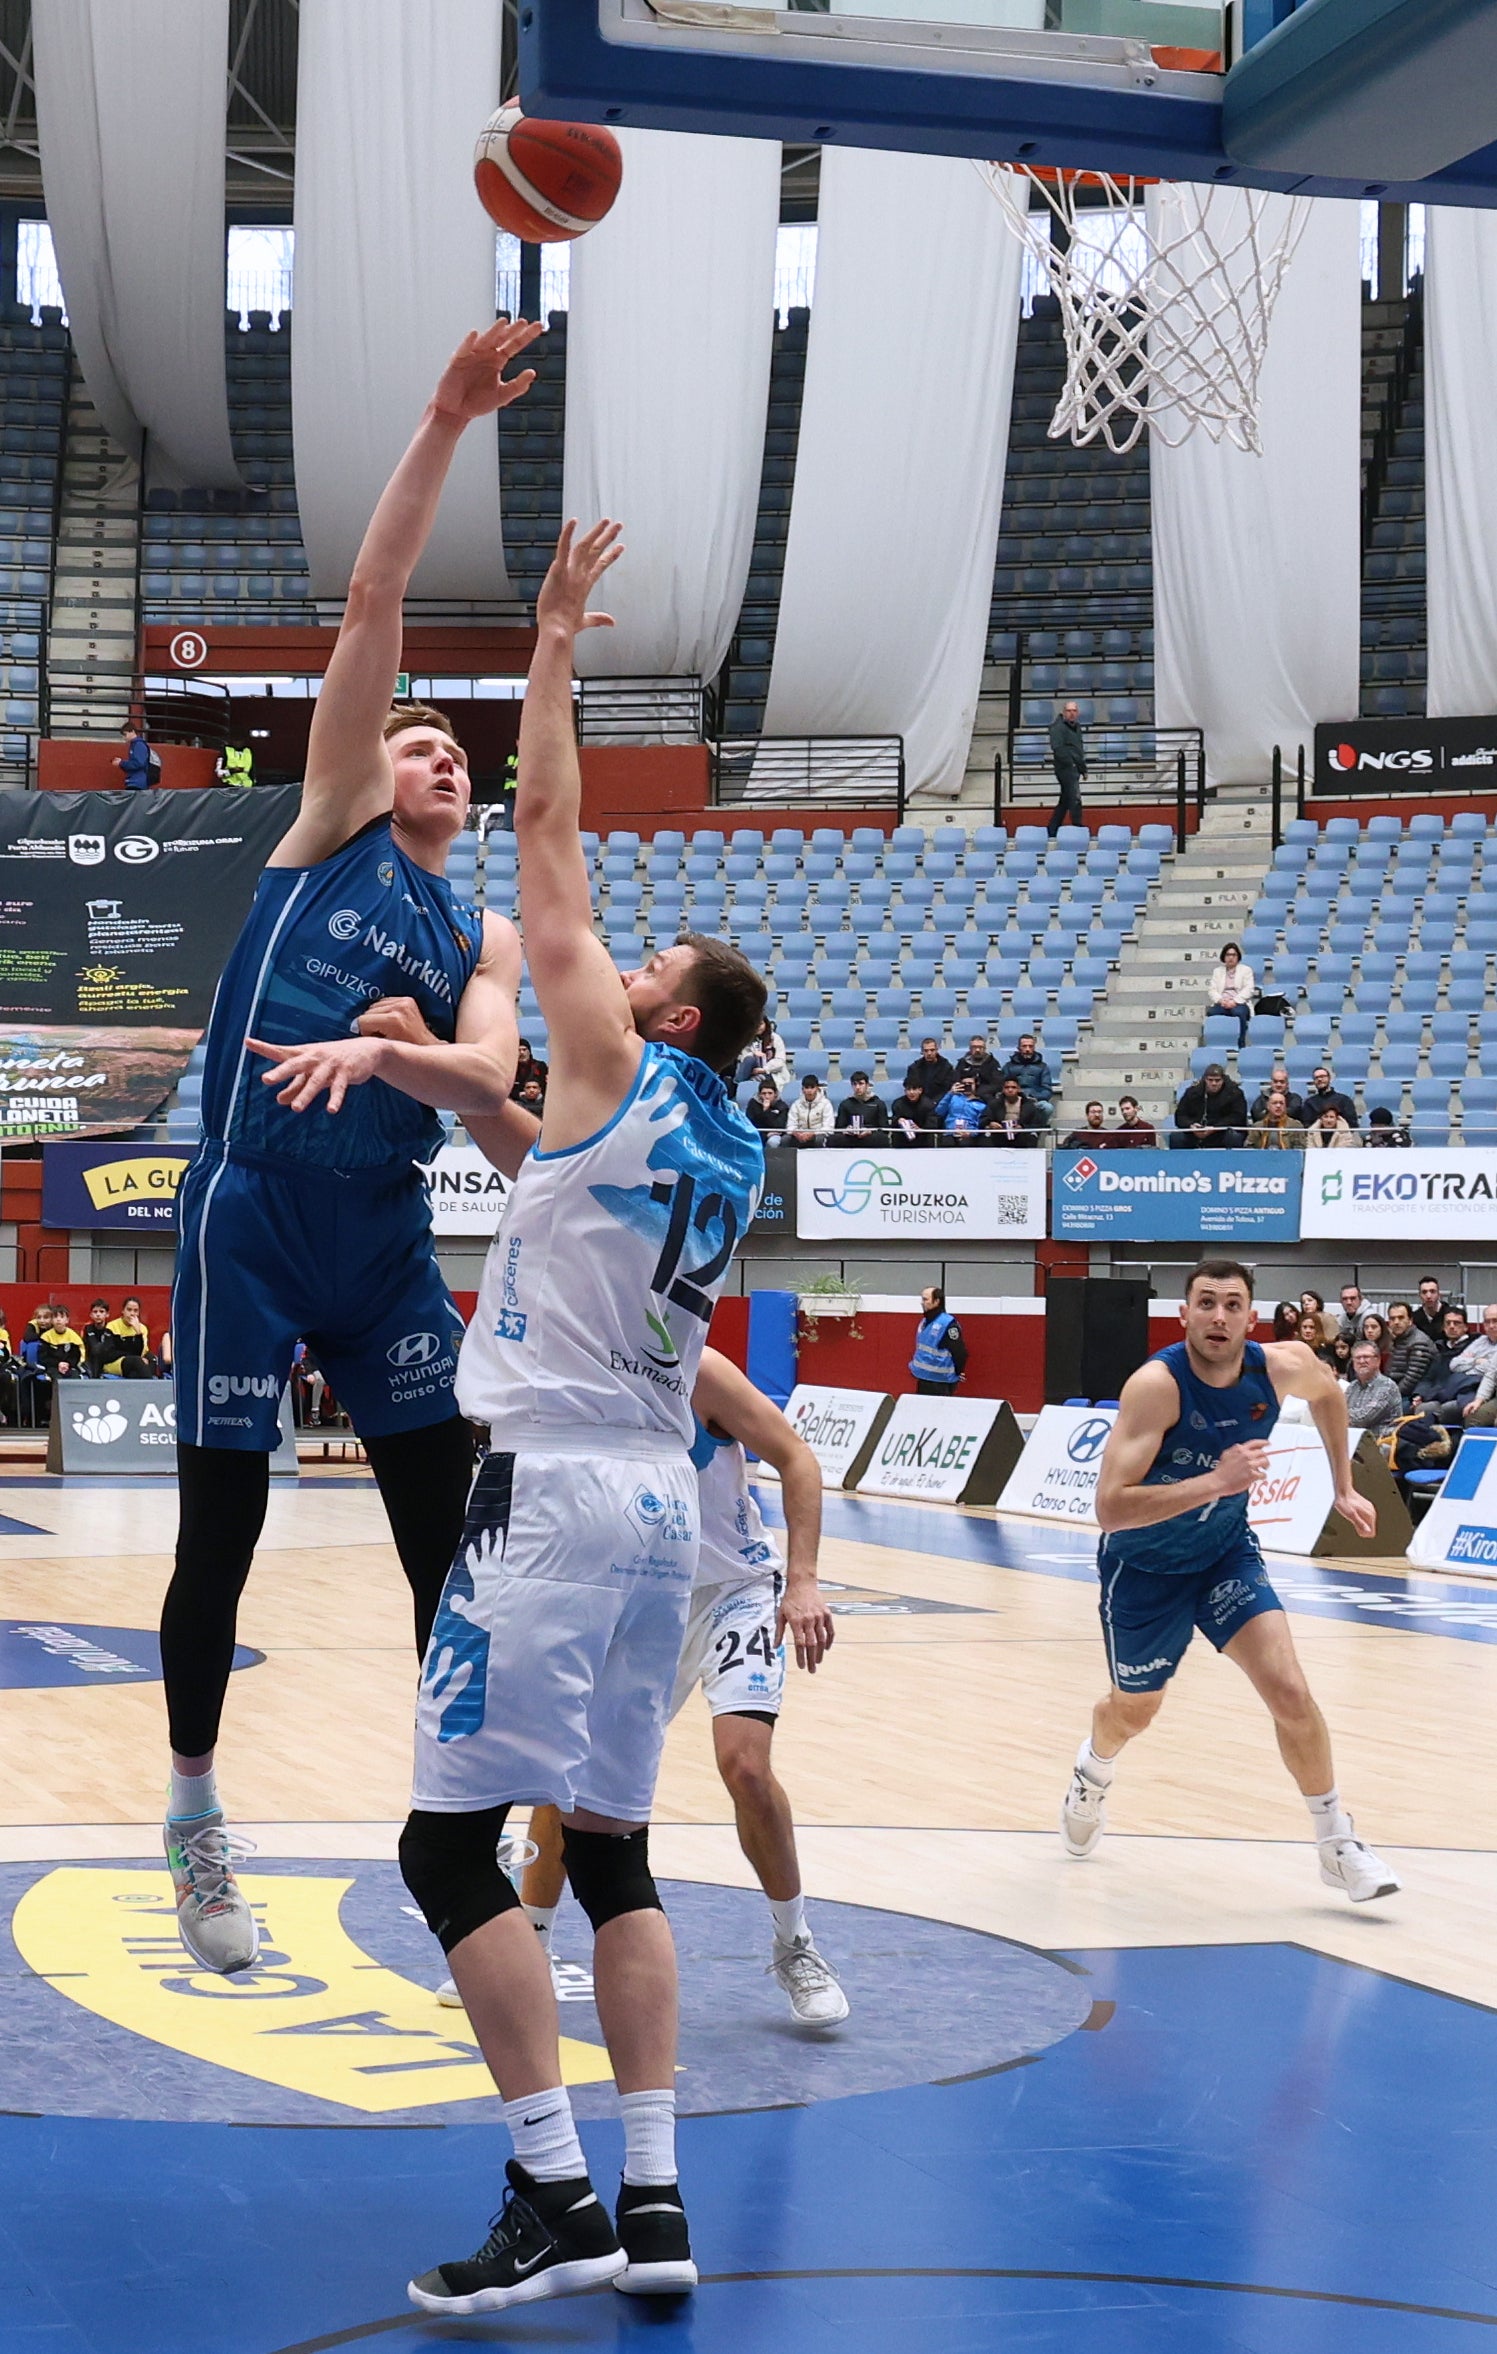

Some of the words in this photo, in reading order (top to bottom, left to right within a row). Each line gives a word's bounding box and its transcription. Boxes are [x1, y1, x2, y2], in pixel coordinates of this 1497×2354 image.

[182, 640, 196, 660] 8
[1357, 749, 1434, 770] NGS
[1218, 894, 1238, 902] FILA
[1204, 922, 1223, 930] FILA
[306, 957, 386, 1000] GIPUZKO
[1179, 978, 1198, 986] FILA
[1155, 1041, 1174, 1049] FILA
[9, 1097, 78, 1110] CUIDA
[0, 1109, 79, 1122] LANETA
[104, 1173, 138, 1194] LA
[1099, 1170, 1212, 1194] Domino's
[1219, 1170, 1287, 1194] Pizza
[1352, 1173, 1497, 1200] EKOTRA
[439, 1201, 457, 1212] DE
[462, 1201, 508, 1212] SALUD
[764, 1192, 783, 1206] de
[880, 1193, 969, 1207] GIPUZKOA
[1352, 1203, 1417, 1214] TRANSPORTE
[128, 1206, 151, 1218] DEL
[754, 1206, 784, 1219] ción
[880, 1209, 966, 1224] TURISMOA
[649, 1171, 737, 1323] 12
[388, 1355, 454, 1387] HYUNDAI
[391, 1384, 436, 1402] Oarso
[439, 1375, 456, 1388] Ca
[881, 1428, 978, 1469] URKABE
[1044, 1467, 1099, 1489] HYUNDA
[1032, 1492, 1066, 1511] Oarso
[1069, 1497, 1092, 1514] Car
[1450, 1530, 1497, 1560] #Kiro
[715, 1625, 776, 1675] 24
